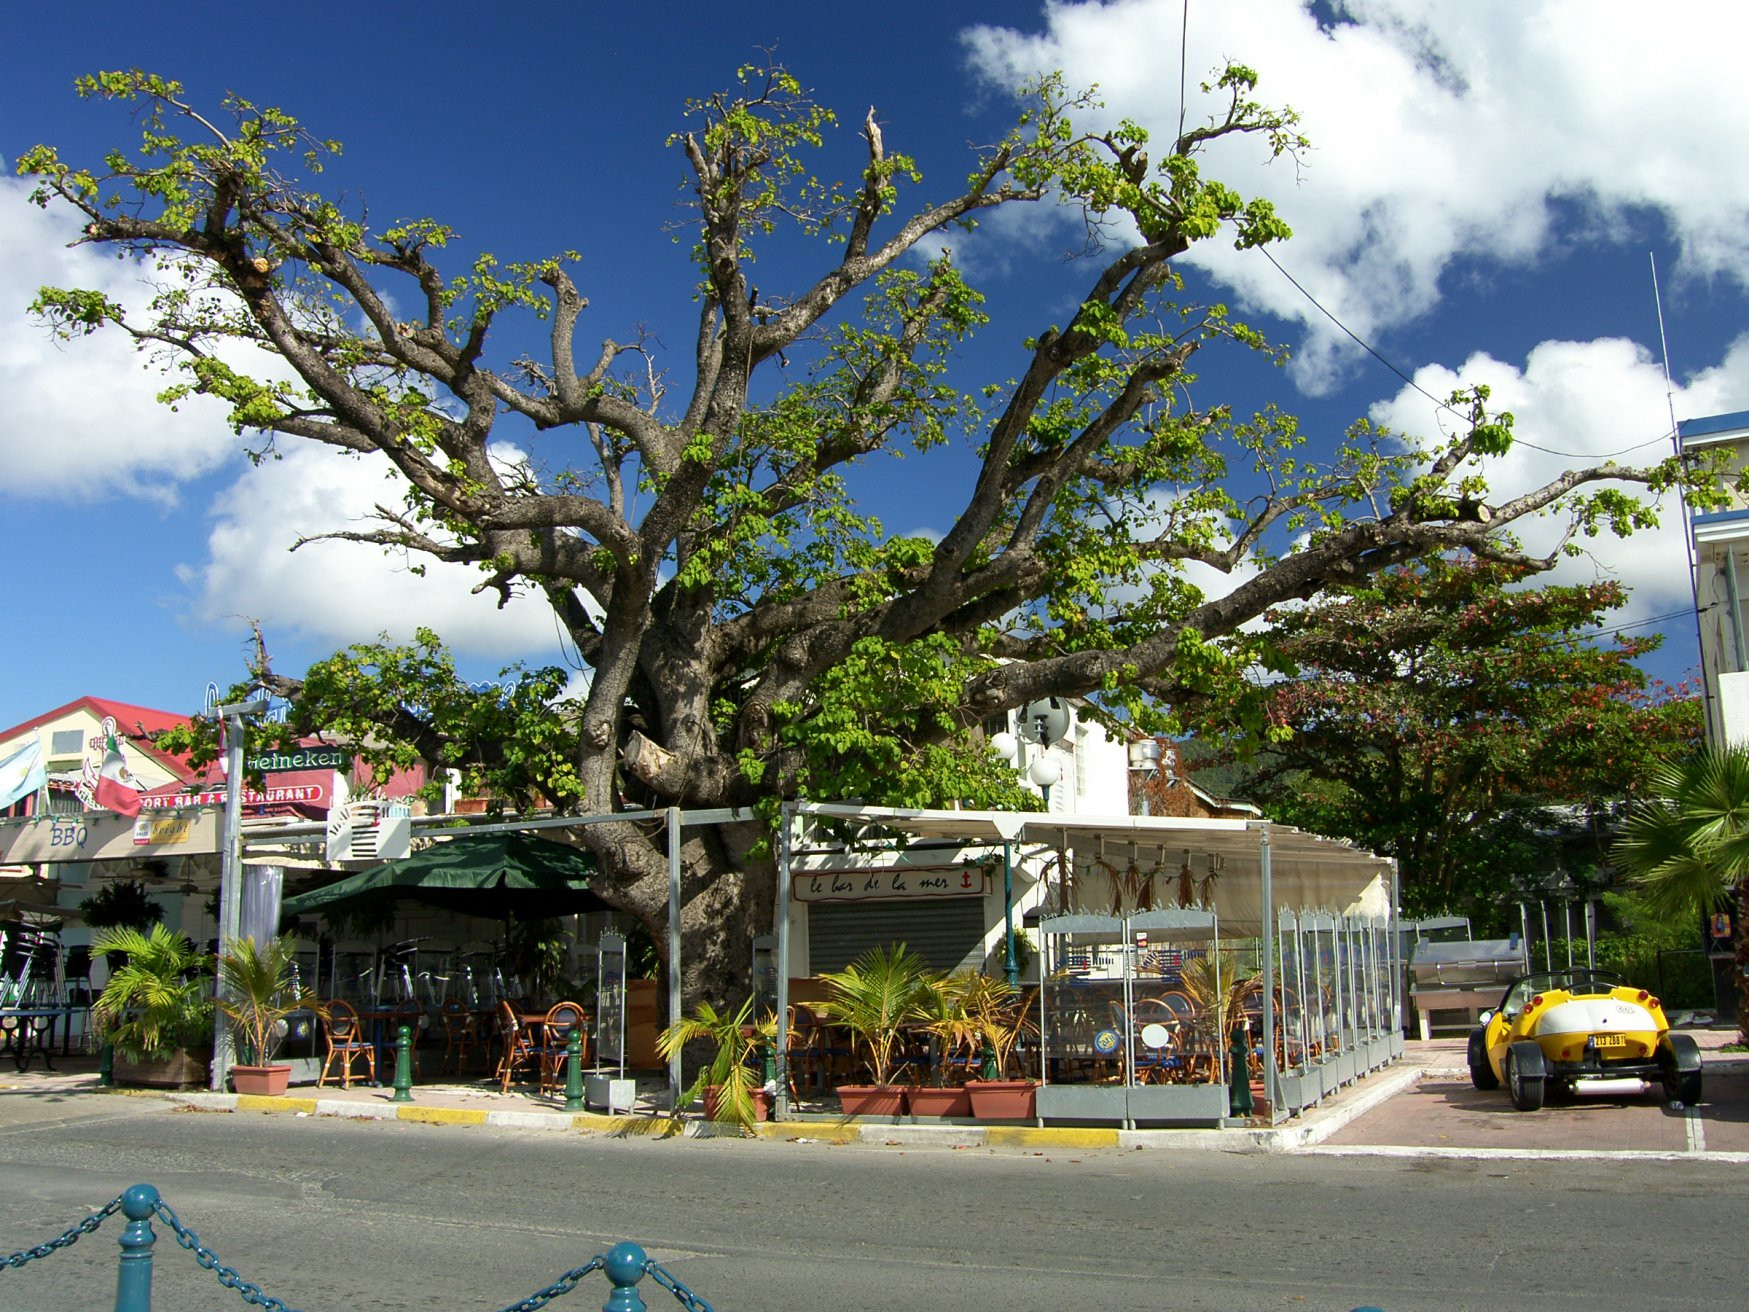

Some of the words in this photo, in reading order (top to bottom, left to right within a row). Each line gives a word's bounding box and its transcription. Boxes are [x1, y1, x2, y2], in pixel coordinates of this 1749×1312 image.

[220, 788, 314, 804] RSTAURANT
[50, 826, 88, 849] BBQ
[153, 822, 188, 837] bright
[810, 875, 822, 893] le
[831, 874, 854, 893] bar
[863, 873, 881, 889] de
[891, 873, 907, 891] la
[920, 876, 949, 889] mer
